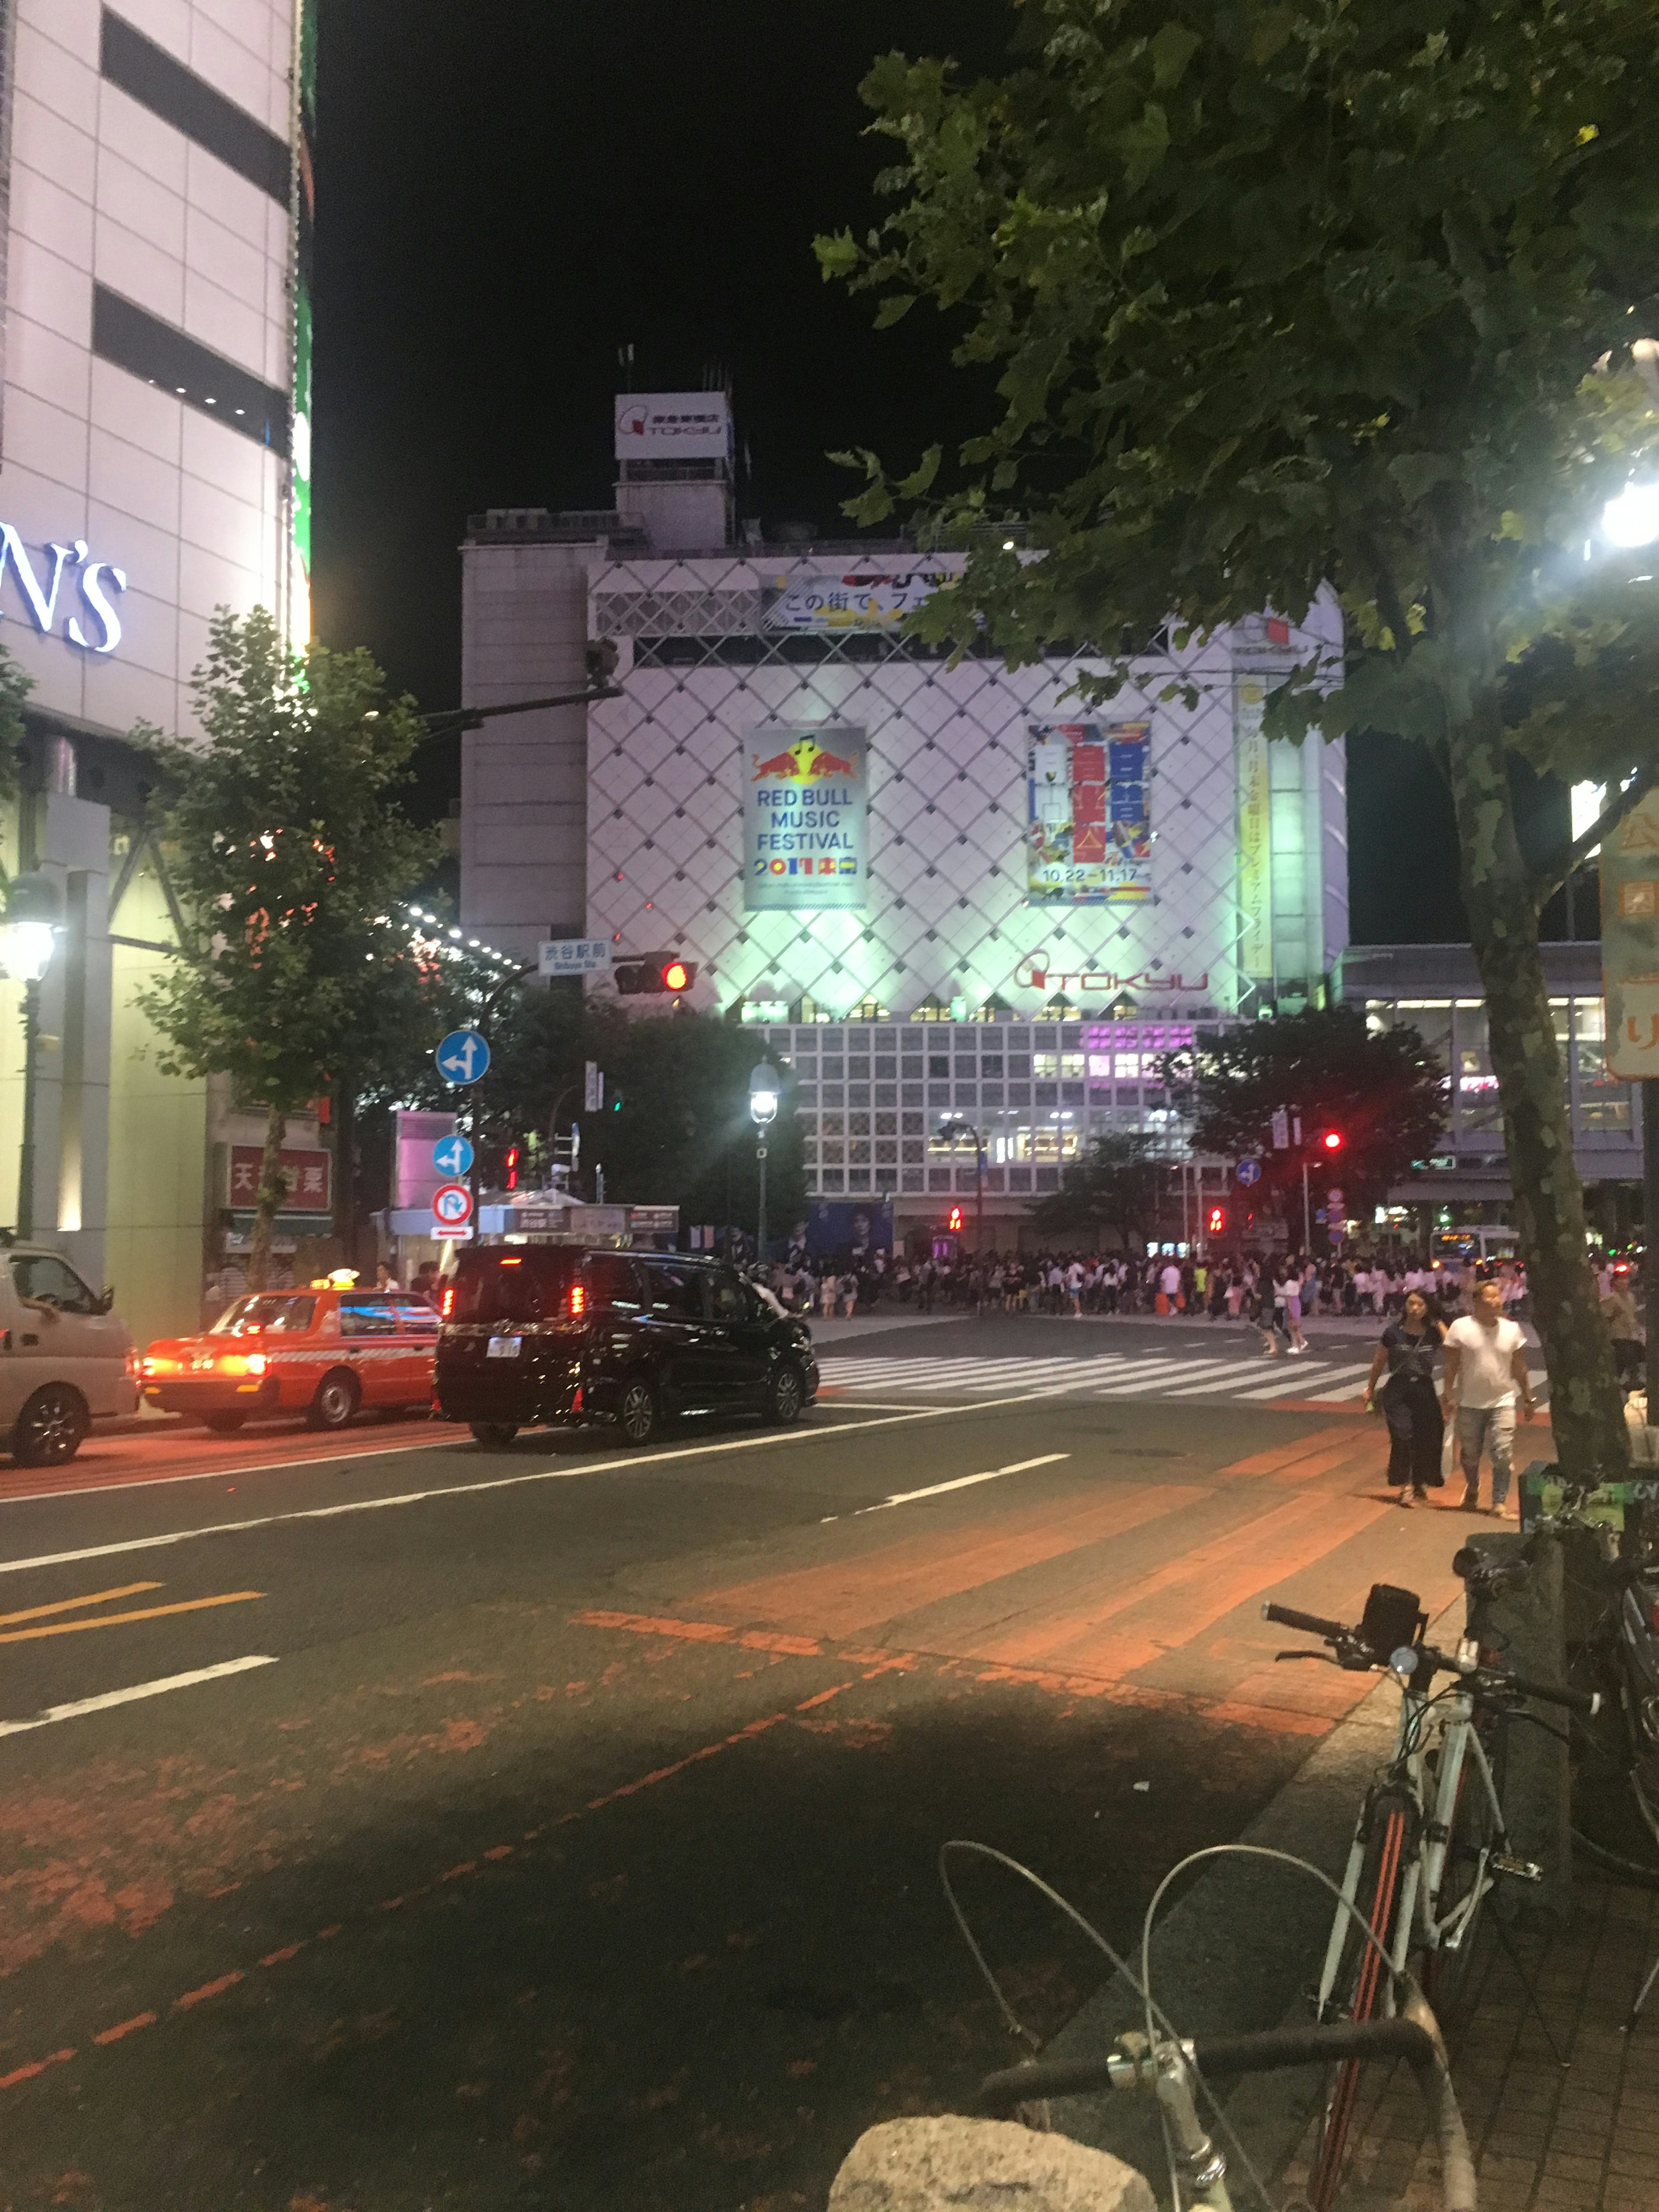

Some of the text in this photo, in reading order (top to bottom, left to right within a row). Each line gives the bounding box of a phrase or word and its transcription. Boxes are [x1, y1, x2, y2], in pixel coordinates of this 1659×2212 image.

[757, 788, 853, 807] RED BULL
[771, 810, 841, 829] MUSIC
[757, 832, 854, 850] FESTIVAL
[1046, 972, 1209, 991] TOKYU
[234, 1162, 323, 1193] 天甘栗
